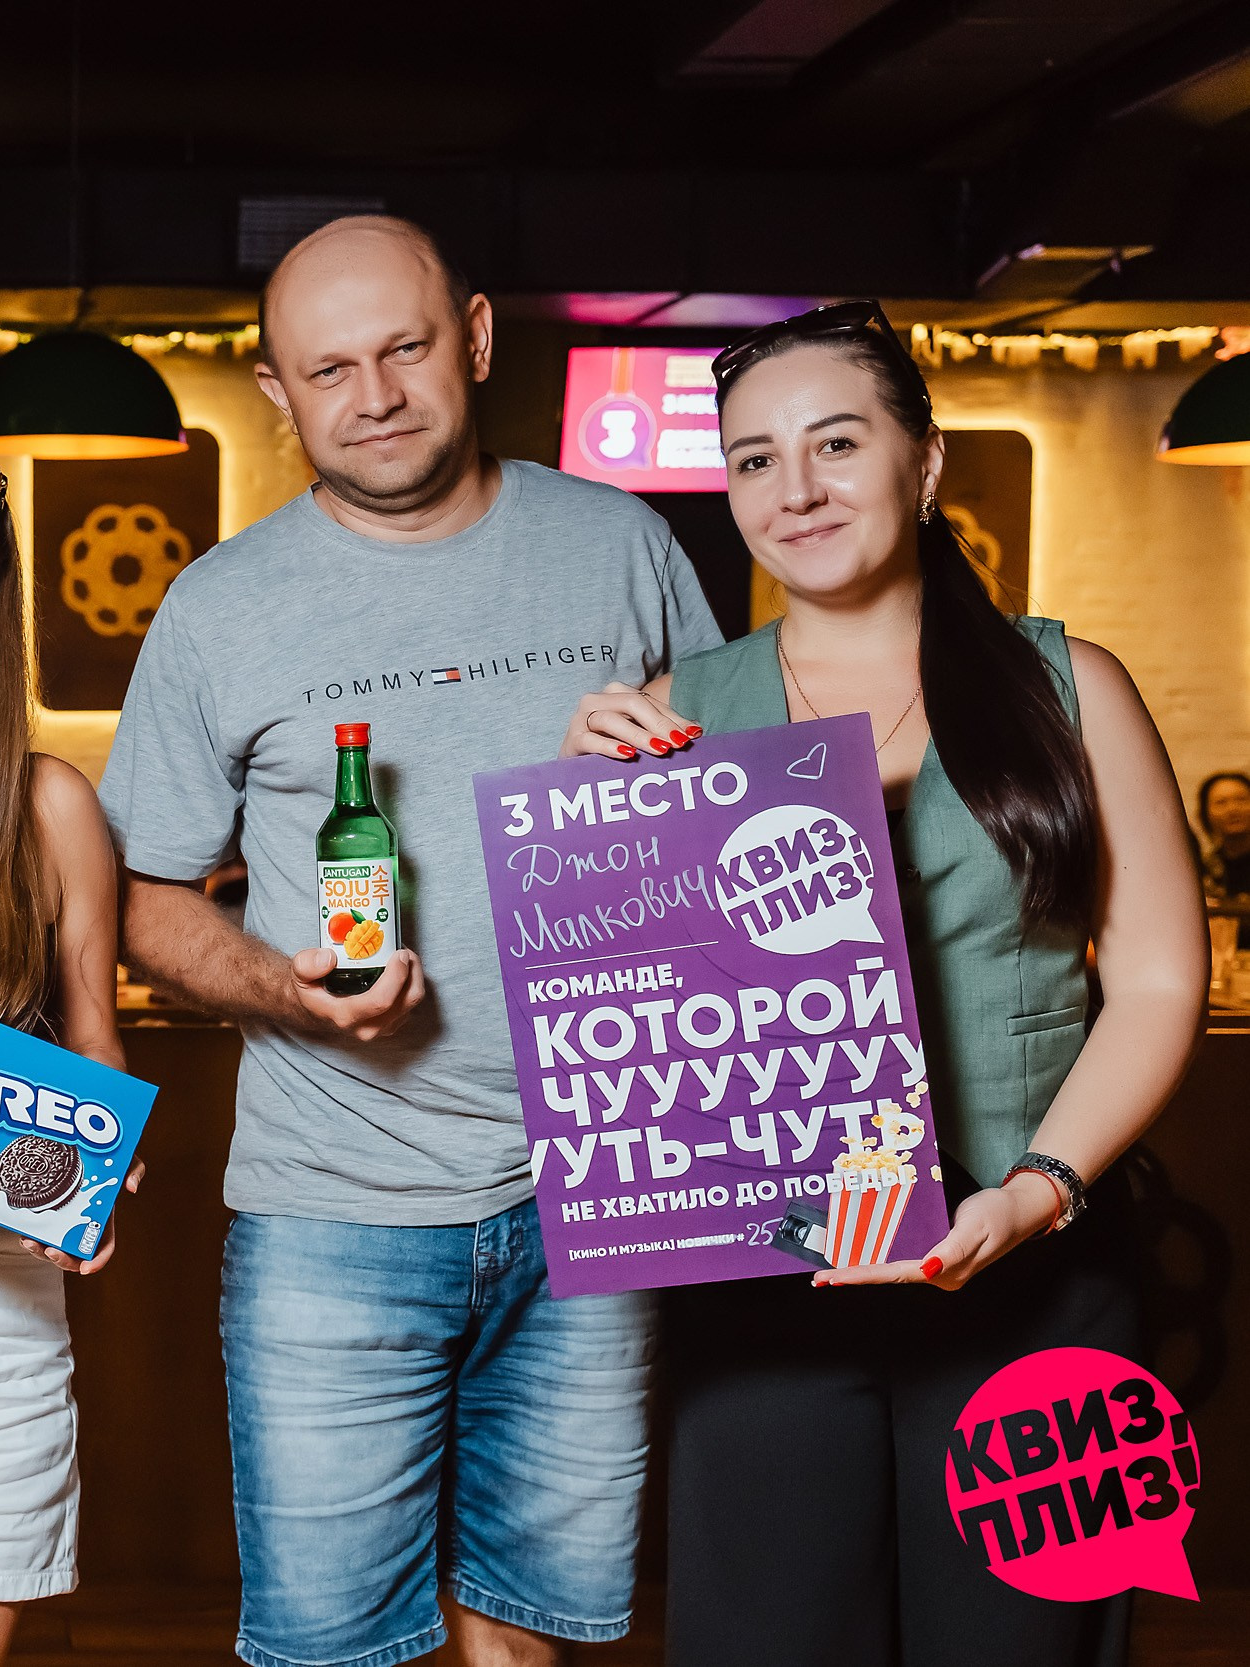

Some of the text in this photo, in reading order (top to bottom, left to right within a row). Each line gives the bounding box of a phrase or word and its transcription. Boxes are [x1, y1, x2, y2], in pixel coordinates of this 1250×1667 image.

[302, 645, 615, 703] TOMMY HILFIGER
[500, 762, 748, 837] 3 МЕСТО
[324, 867, 370, 878] JANTUGAN
[506, 836, 660, 893] Джон
[324, 879, 370, 898] SOJU
[328, 897, 370, 908] MANGO
[371, 865, 389, 906] 소주
[509, 864, 716, 958] Малкович
[527, 963, 684, 1003] КОМАНДЕ,
[533, 956, 903, 1068] КОТОРОЙ
[20, 1155, 46, 1171] OREO
[561, 1200, 597, 1223] НЕ
[600, 1185, 730, 1220] ХВАТИЛО
[736, 1181, 779, 1208] ДО
[568, 1246, 607, 1261] [КИНО
[609, 1245, 618, 1256] И
[619, 1239, 676, 1256] МУЗЫКА]
[746, 1217, 784, 1246] 25
